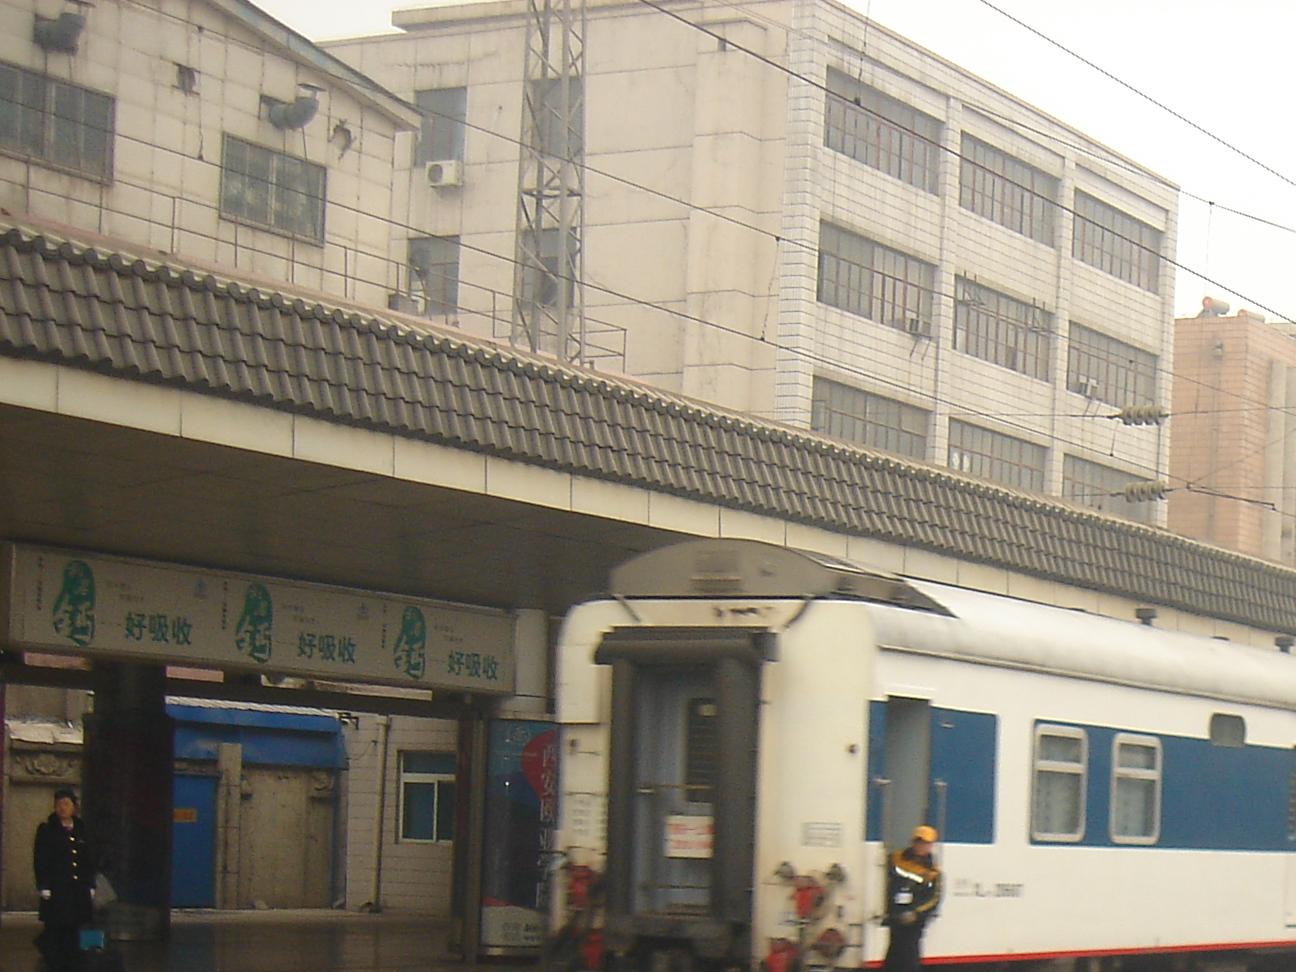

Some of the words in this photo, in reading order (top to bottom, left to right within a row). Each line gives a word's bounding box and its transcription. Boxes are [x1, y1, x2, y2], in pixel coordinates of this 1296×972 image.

[125, 611, 192, 645] 好吸收
[297, 631, 357, 664] 好吸收
[447, 650, 499, 681] 好吸收
